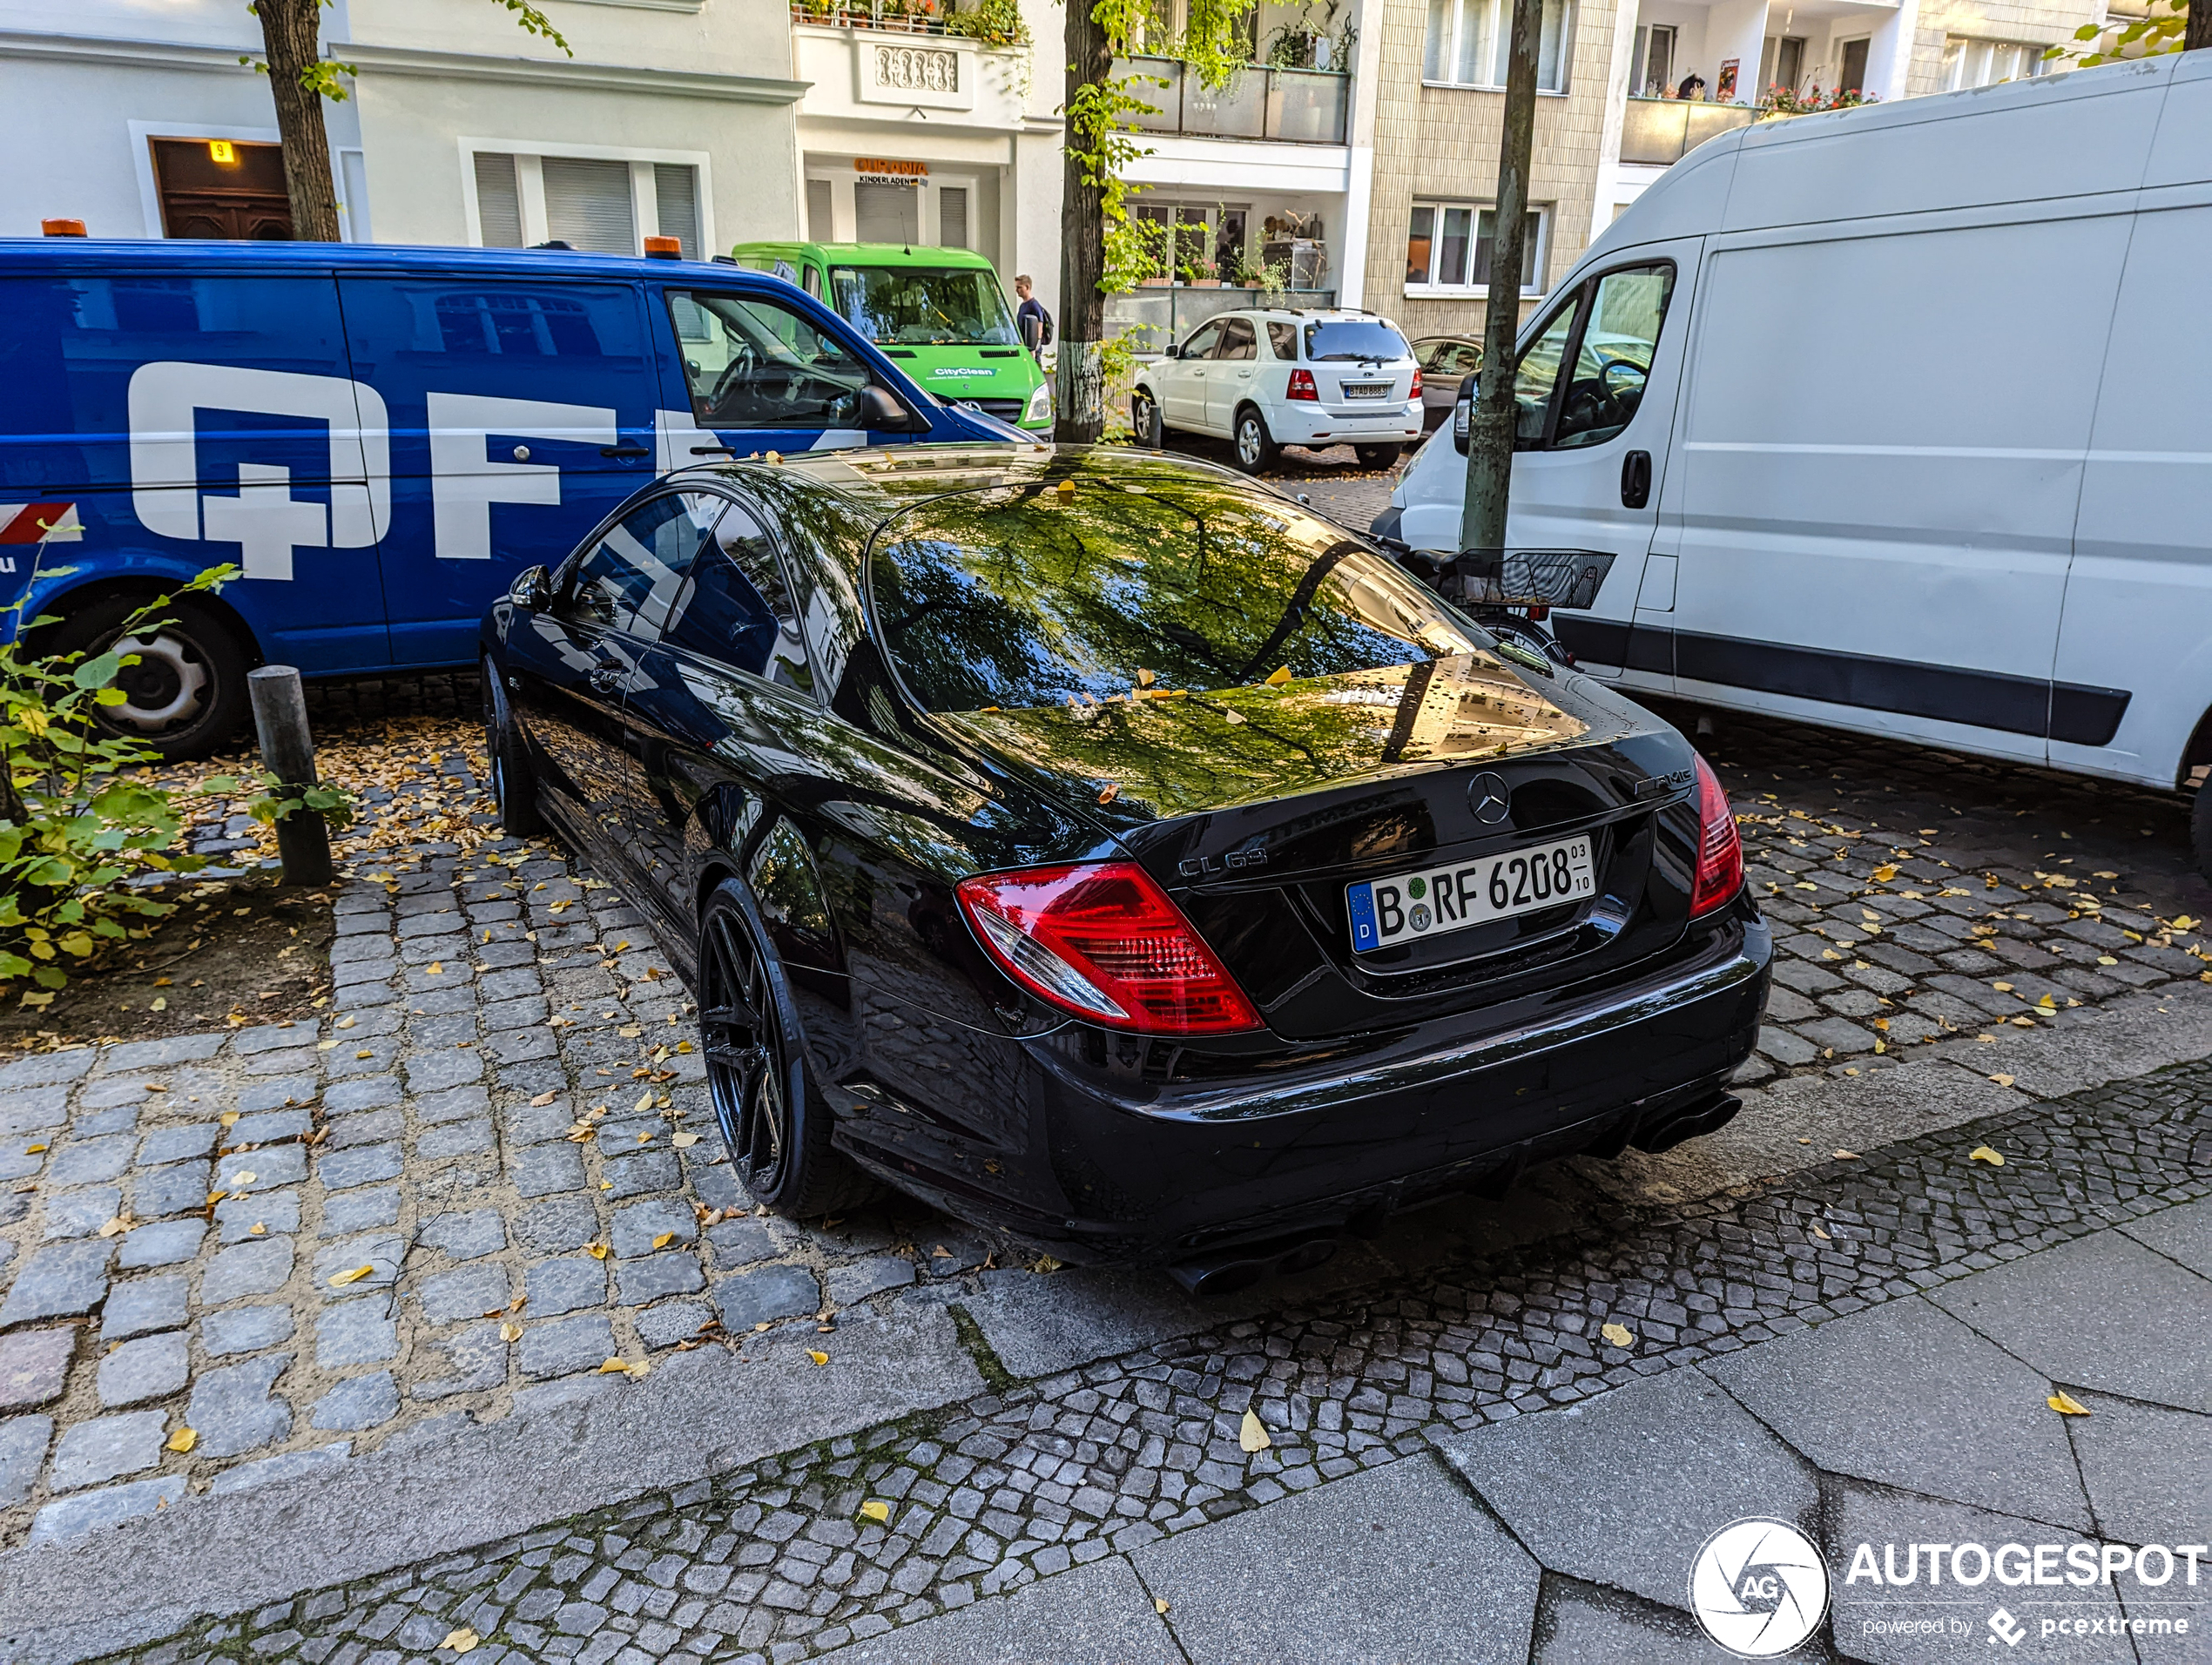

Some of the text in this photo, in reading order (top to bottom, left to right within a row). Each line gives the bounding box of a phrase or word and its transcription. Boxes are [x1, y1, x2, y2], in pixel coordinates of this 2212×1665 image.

[217, 144, 224, 157] 9
[854, 158, 928, 176] OURANIA
[860, 175, 910, 185] KINDERLADEN
[1350, 387, 1355, 395] B
[1359, 387, 1368, 395] AD
[1571, 844, 1586, 859] 03
[1178, 847, 1268, 877] CL 63
[1575, 876, 1589, 892] 10
[1376, 886, 1405, 937] B
[1432, 867, 1477, 924] RF
[1489, 848, 1572, 909] 6208
[1359, 923, 1370, 939] D
